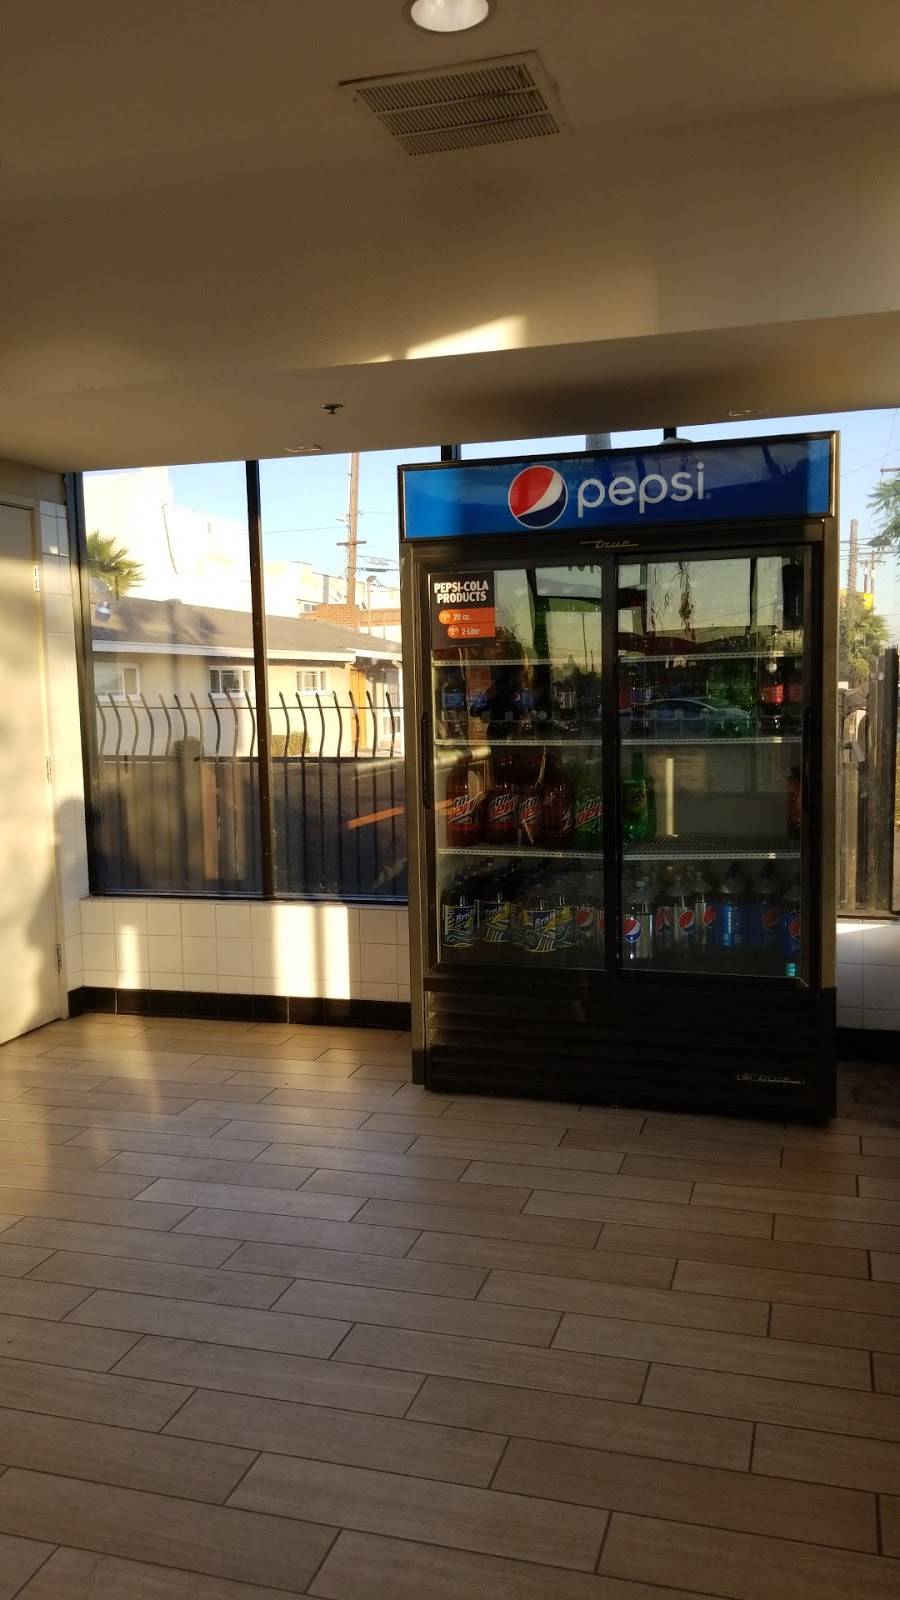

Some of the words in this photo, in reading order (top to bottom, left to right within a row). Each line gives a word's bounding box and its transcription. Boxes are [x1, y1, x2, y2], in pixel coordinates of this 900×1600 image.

[577, 462, 705, 518] pepsi
[433, 580, 489, 594] PEPSI-COLA
[436, 591, 487, 604] PRODUCTS
